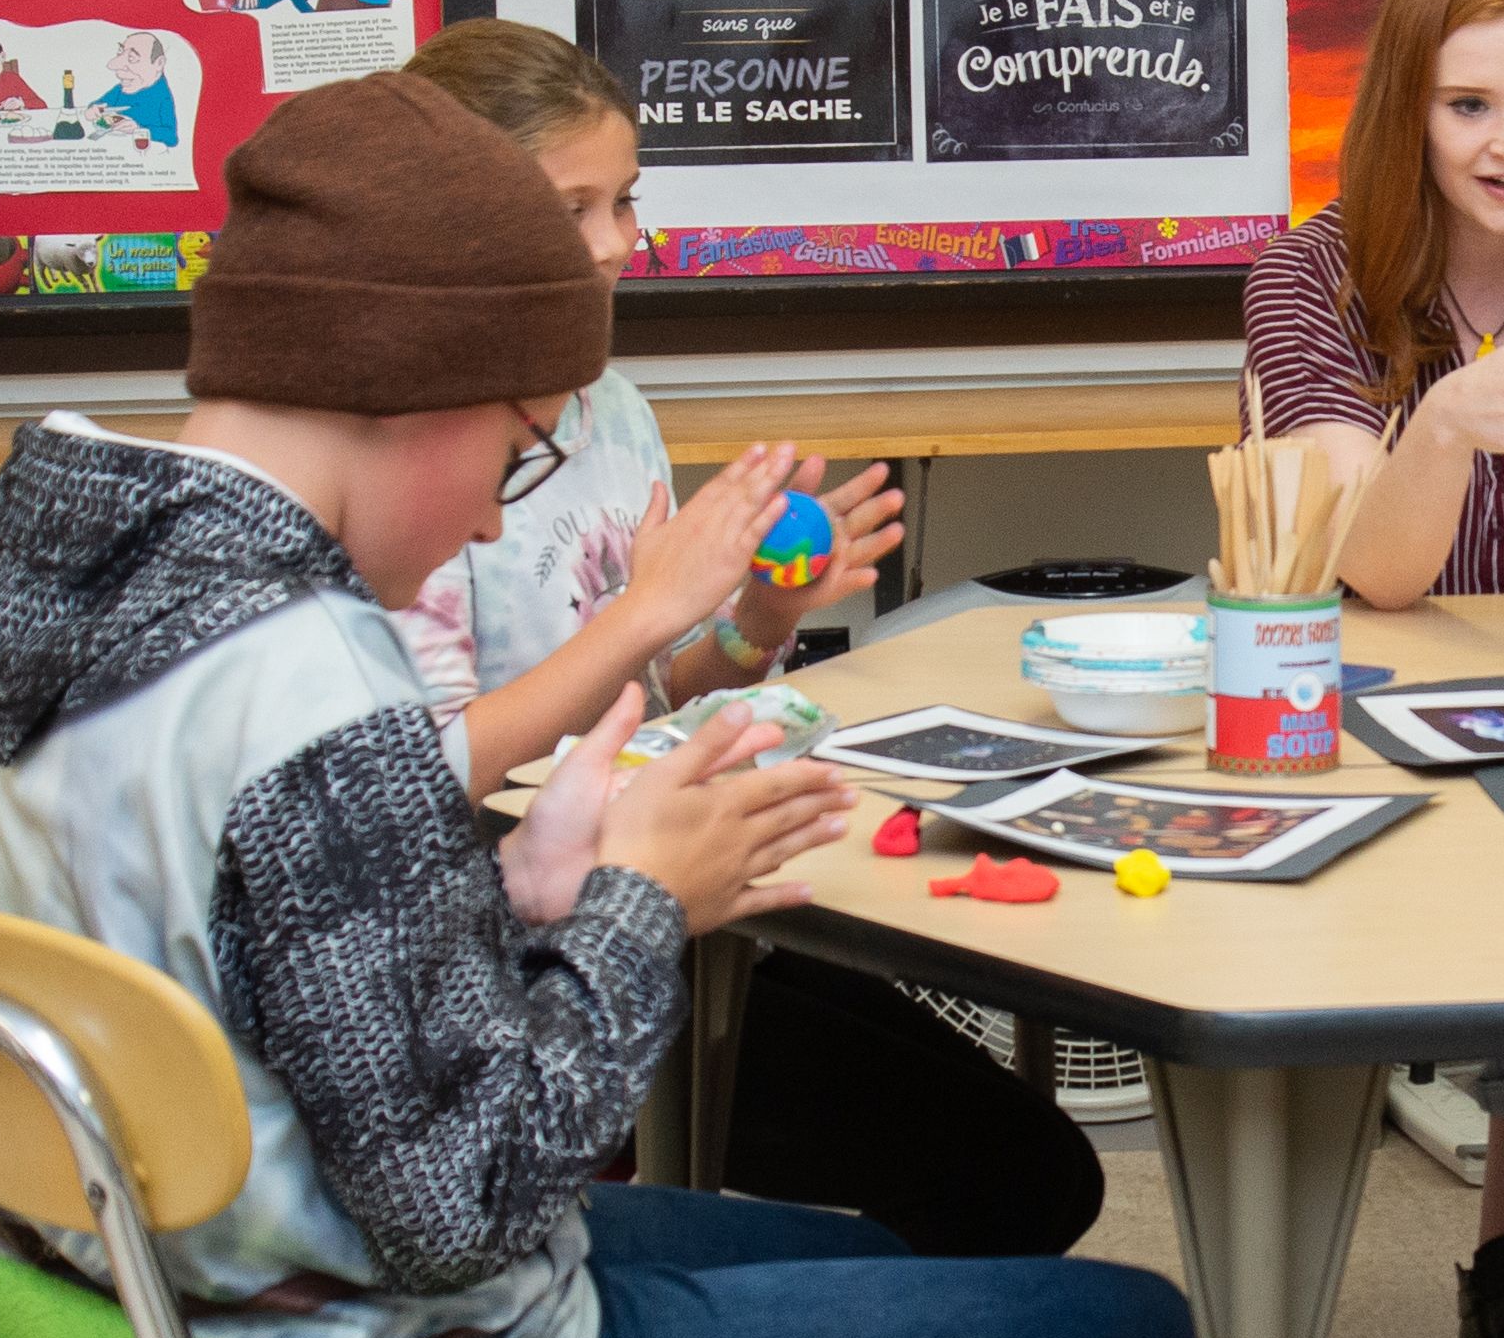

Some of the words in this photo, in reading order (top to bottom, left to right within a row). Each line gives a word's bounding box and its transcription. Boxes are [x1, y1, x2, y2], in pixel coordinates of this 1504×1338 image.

[978, 5, 1002, 26] Je
[1174, 0, 1195, 25] je
[702, 17, 748, 34] sans
[754, 16, 796, 44] que
[639, 57, 851, 96] PERSONNE
[957, 39, 1211, 93] Comprends.
[638, 102, 684, 124] NE
[697, 102, 732, 123] LE
[745, 99, 862, 122] SACHE.
[875, 224, 999, 260] Excellent!
